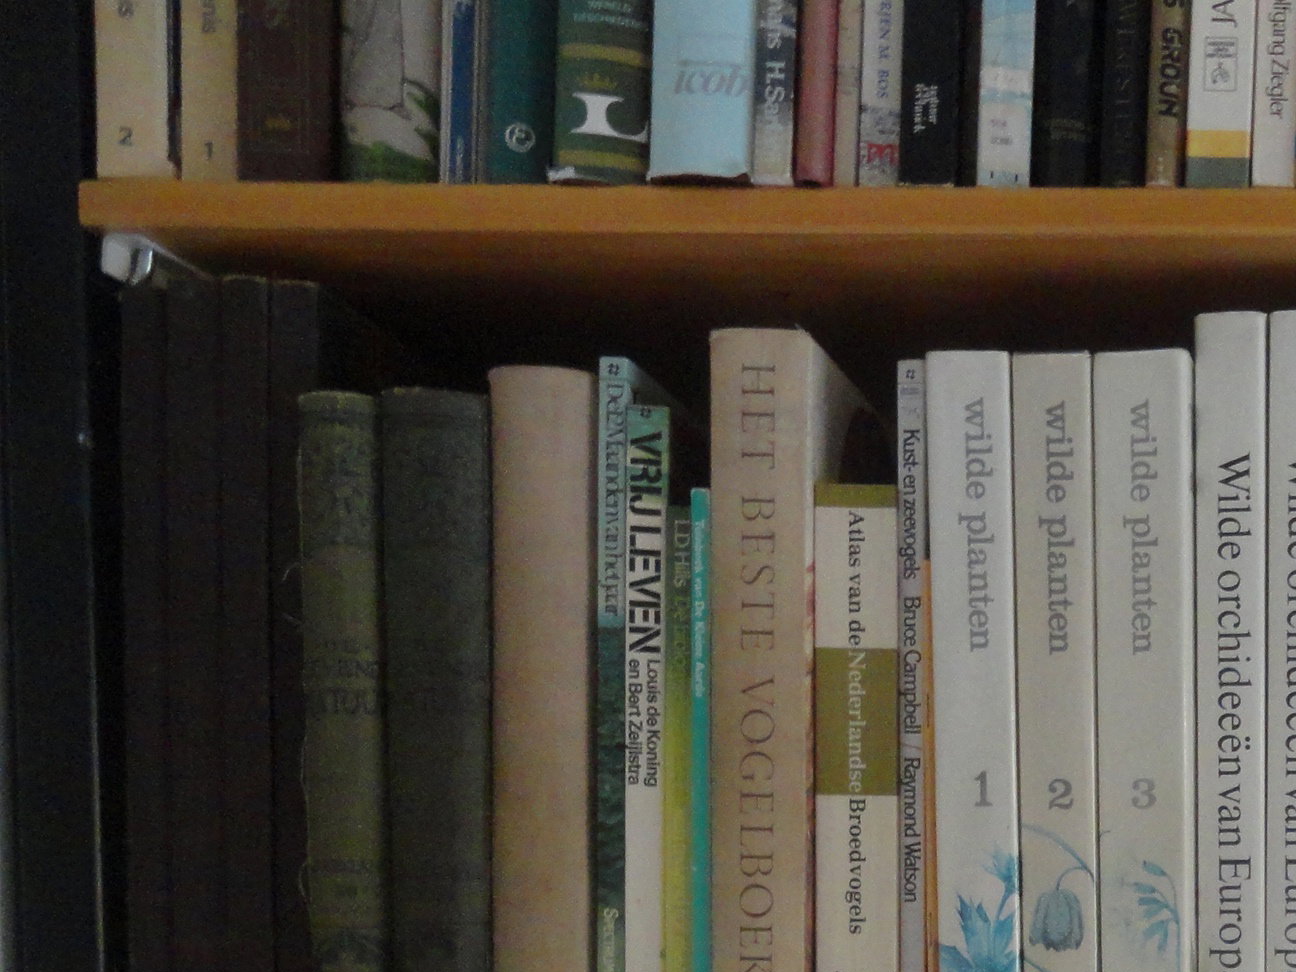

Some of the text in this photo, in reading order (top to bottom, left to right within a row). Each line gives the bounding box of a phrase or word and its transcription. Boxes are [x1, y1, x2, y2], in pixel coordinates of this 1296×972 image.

[740, 364, 776, 469] HET
[1218, 452, 1252, 558] Wilde
[627, 432, 662, 653] VRIJ LEVEN
[740, 497, 775, 653] BESTE
[958, 398, 995, 807] wilde planten 1
[1037, 401, 1075, 811] wilde planten 2
[1122, 401, 1158, 811] wilde planten 3
[625, 659, 642, 786] en Bert Zeijlstra
[640, 659, 659, 788] Louis de Koning
[843, 511, 867, 935] Atlas van de Nederlandse Broedvogels
[1218, 570, 1252, 777] orchideeën
[1219, 787, 1237, 847] van
